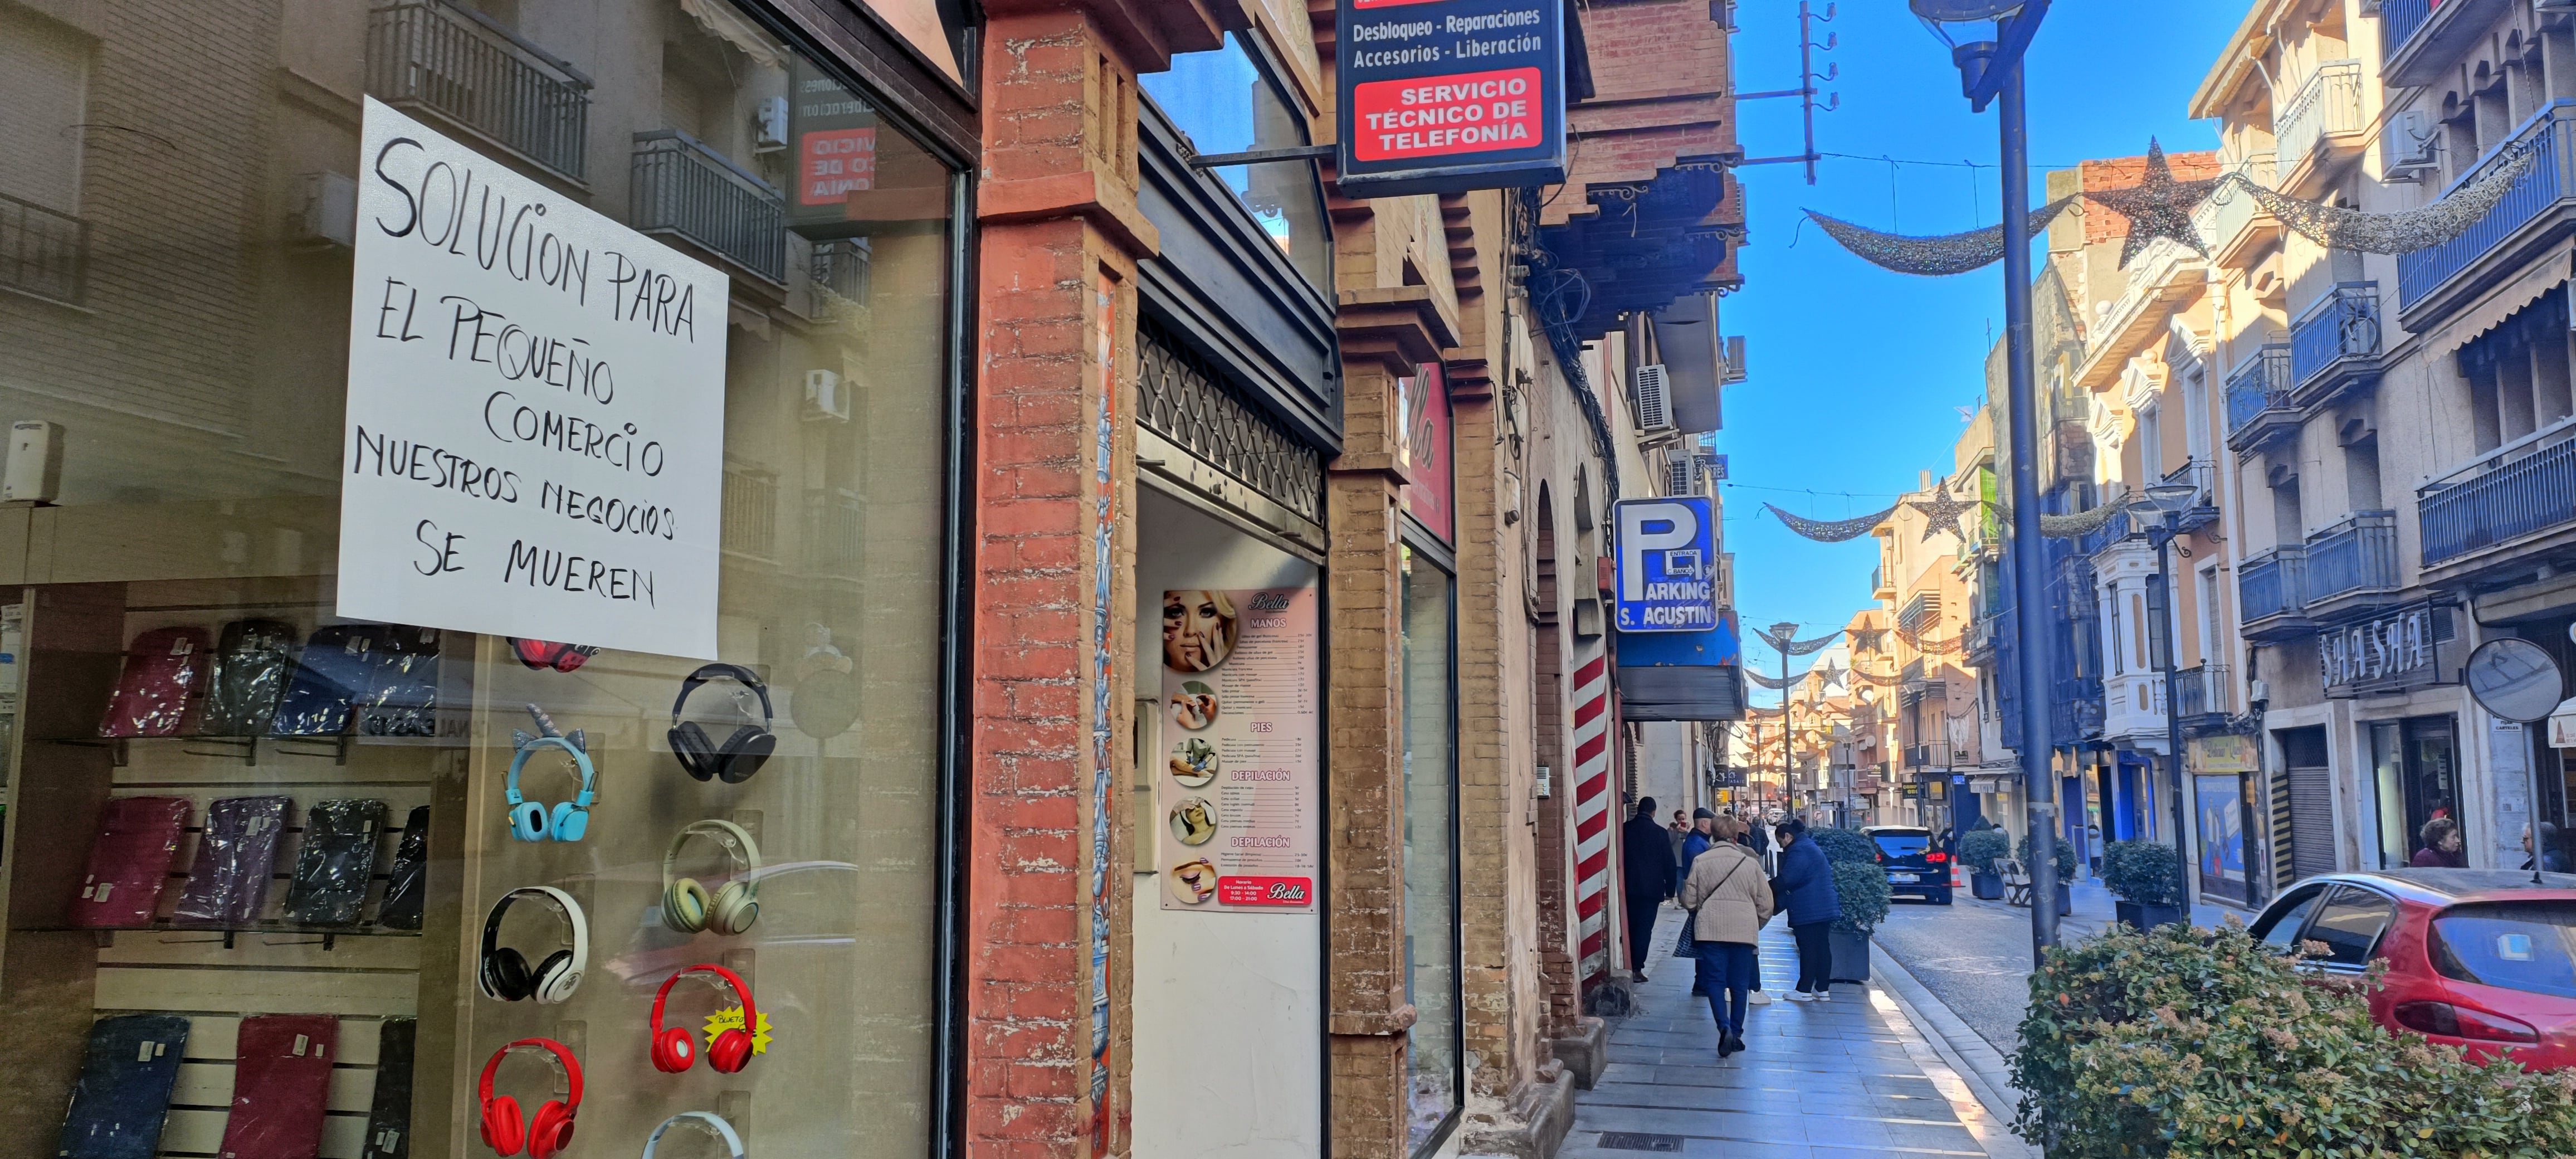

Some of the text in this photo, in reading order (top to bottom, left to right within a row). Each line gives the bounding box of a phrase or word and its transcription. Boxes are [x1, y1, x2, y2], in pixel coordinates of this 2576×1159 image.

[1353, 21, 1432, 42] Desbloqueo
[1446, 9, 1540, 35] Reparaciones
[1354, 45, 1440, 68] Accesorios
[1456, 32, 1541, 59] Liberación
[1401, 78, 1526, 106] SERVICIO
[1365, 100, 1527, 130] TÉCNICO DE
[1379, 121, 1528, 150] TELEFONÍA
[605, 251, 694, 343] PARA
[376, 276, 613, 405] EL PEQUEÑO
[354, 425, 521, 503] NUESTROS
[414, 519, 655, 610] SE MUEREN
[1248, 592, 1289, 610] Bella
[1645, 582, 1710, 600] ARKING
[1251, 618, 1286, 628] MANOS
[1621, 606, 1711, 625] S. AGUSTIN
[1251, 722, 1272, 732] PIES
[1231, 768, 1290, 781] DEPILACIÓN
[1231, 835, 1290, 848] DEPILACIÓN
[1267, 883, 1305, 899] Bella
